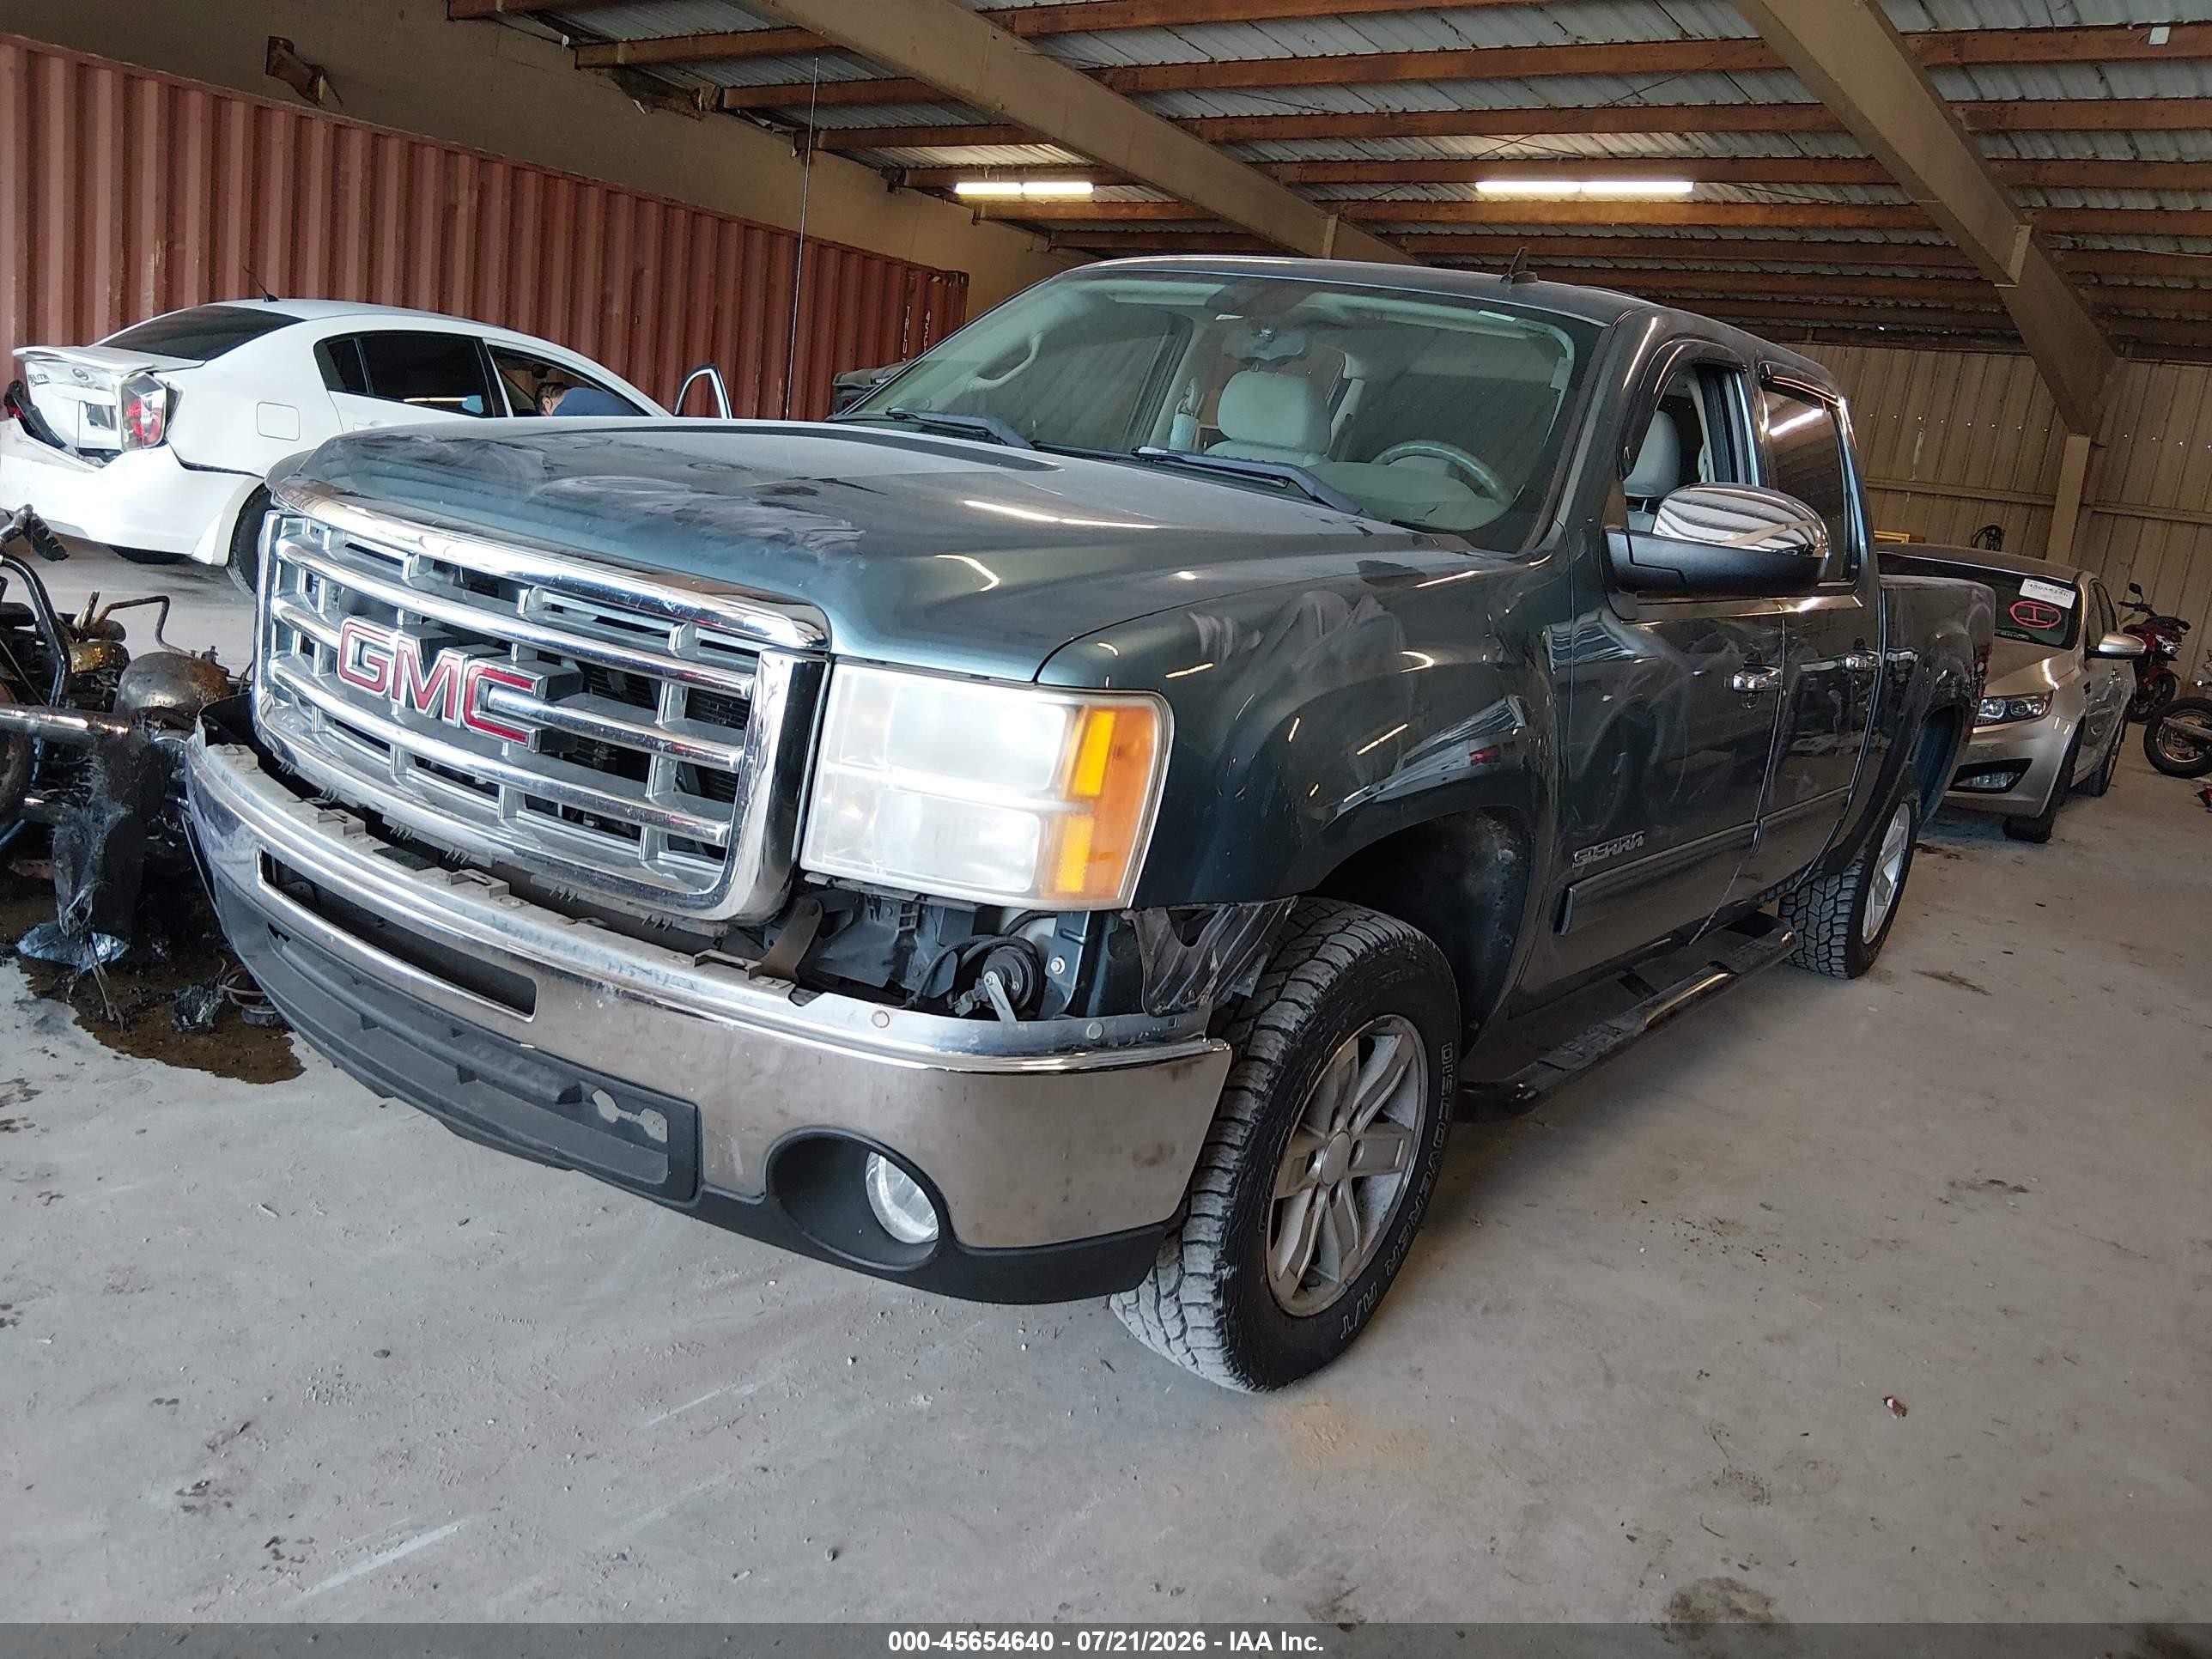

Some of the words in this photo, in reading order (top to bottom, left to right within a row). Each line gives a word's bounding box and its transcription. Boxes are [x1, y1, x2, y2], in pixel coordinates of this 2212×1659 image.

[902, 306, 911, 354] TRLU
[337, 617, 543, 752] GMC
[1571, 830, 1646, 869] SIERRA
[1385, 1042, 1453, 1278] DISCOVERER
